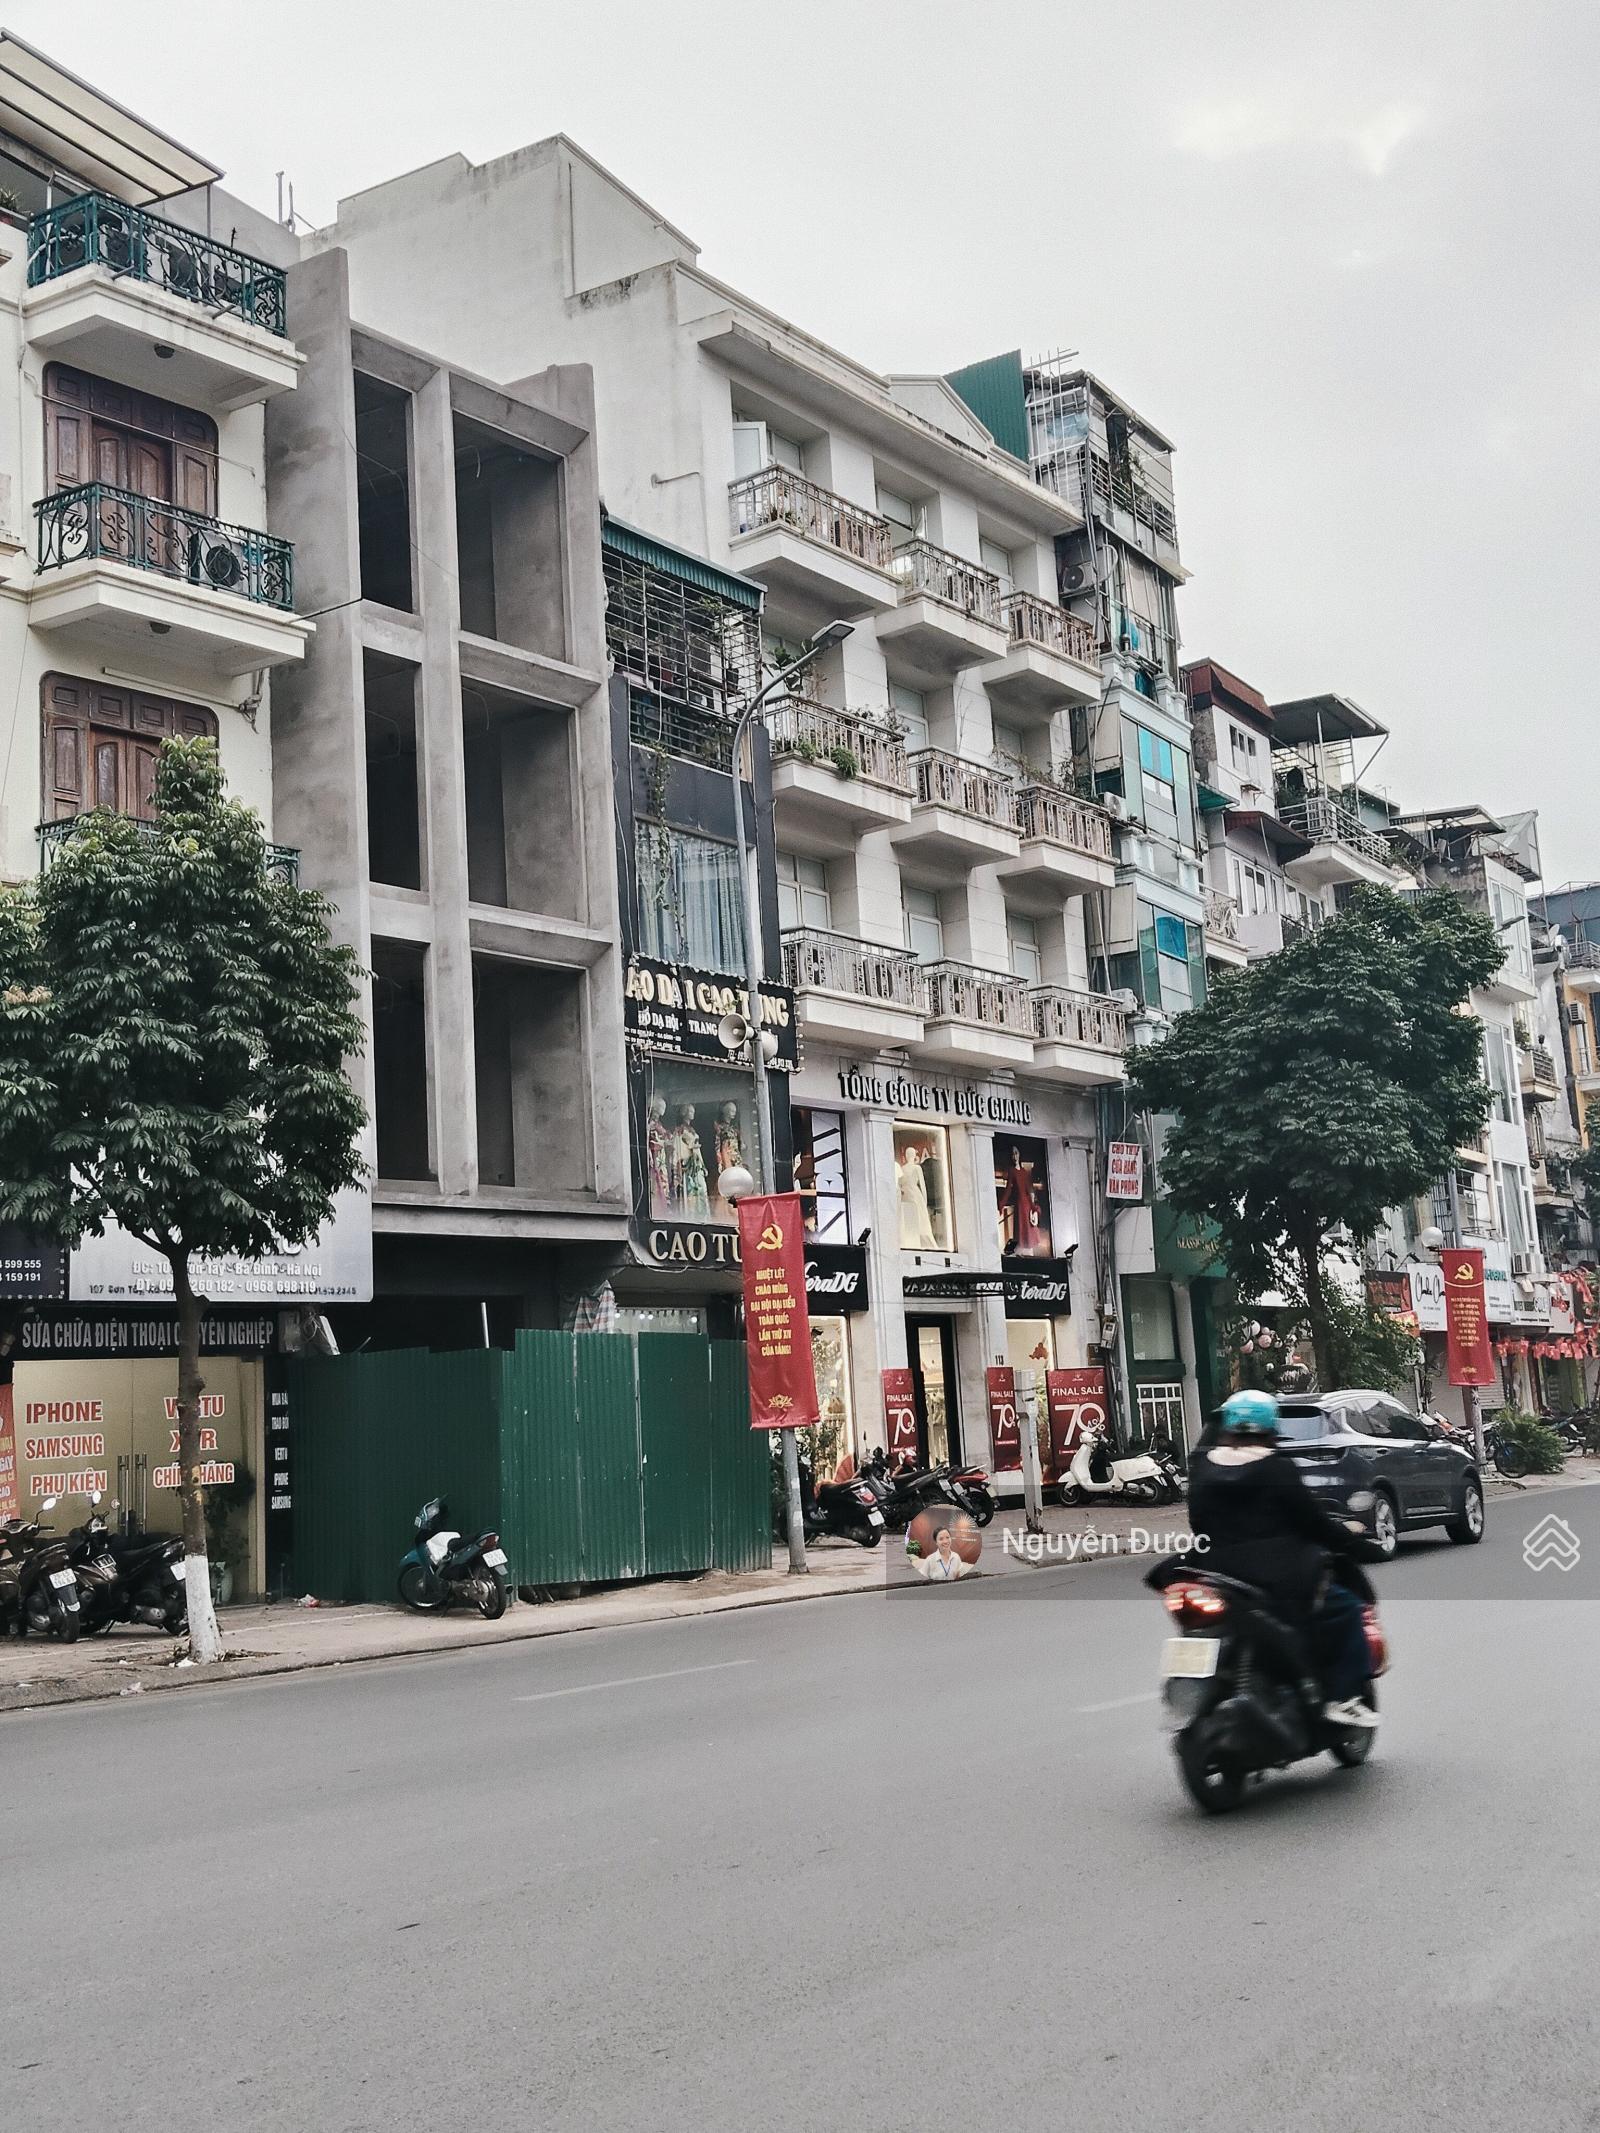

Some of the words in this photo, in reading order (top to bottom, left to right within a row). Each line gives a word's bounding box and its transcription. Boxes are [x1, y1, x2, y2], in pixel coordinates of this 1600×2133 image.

[697, 982, 736, 1016] CAO
[651, 1012, 665, 1030] DẠ
[664, 1013, 680, 1033] HỘI
[688, 1019, 718, 1037] TRANG
[838, 1064, 882, 1103] TỔNG
[932, 1086, 950, 1113] TY
[954, 1086, 985, 1119] ĐỨC
[989, 1095, 1031, 1124] GIANG
[649, 1229, 707, 1262] CAO
[711, 1227, 743, 1263] TÙ
[5, 1259, 23, 1269] 599
[24, 1259, 41, 1269] 555
[157, 1260, 174, 1275] 10
[6, 1272, 23, 1282] 159
[24, 1272, 41, 1282] 191
[215, 1280, 235, 1293] 182
[245, 1280, 274, 1293] 0968
[276, 1280, 298, 1293] 698
[299, 1280, 316, 1293] 119
[22, 1313, 51, 1348] SỬA
[54, 1317, 92, 1348] CHỮA
[95, 1316, 128, 1351] ĐIỆN
[132, 1321, 171, 1351] THOẠI
[174, 1316, 225, 1347] CYÊN
[228, 1316, 274, 1349] NGHIỆP
[994, 1354, 1004, 1366] 113
[900, 1393, 913, 1402] SALE
[1002, 1390, 1014, 1398] SALE
[1052, 1387, 1079, 1397] FINAL
[1080, 1385, 1105, 1395] SALE
[26, 1401, 103, 1424] IPHONE
[164, 1395, 225, 1420] VTU
[25, 1434, 104, 1460] SAMSUNG
[169, 1428, 218, 1453] XR
[31, 1473, 66, 1499] PHỤ
[67, 1467, 107, 1497] KIỆN
[271, 1495, 292, 1510] SAMSUNG
